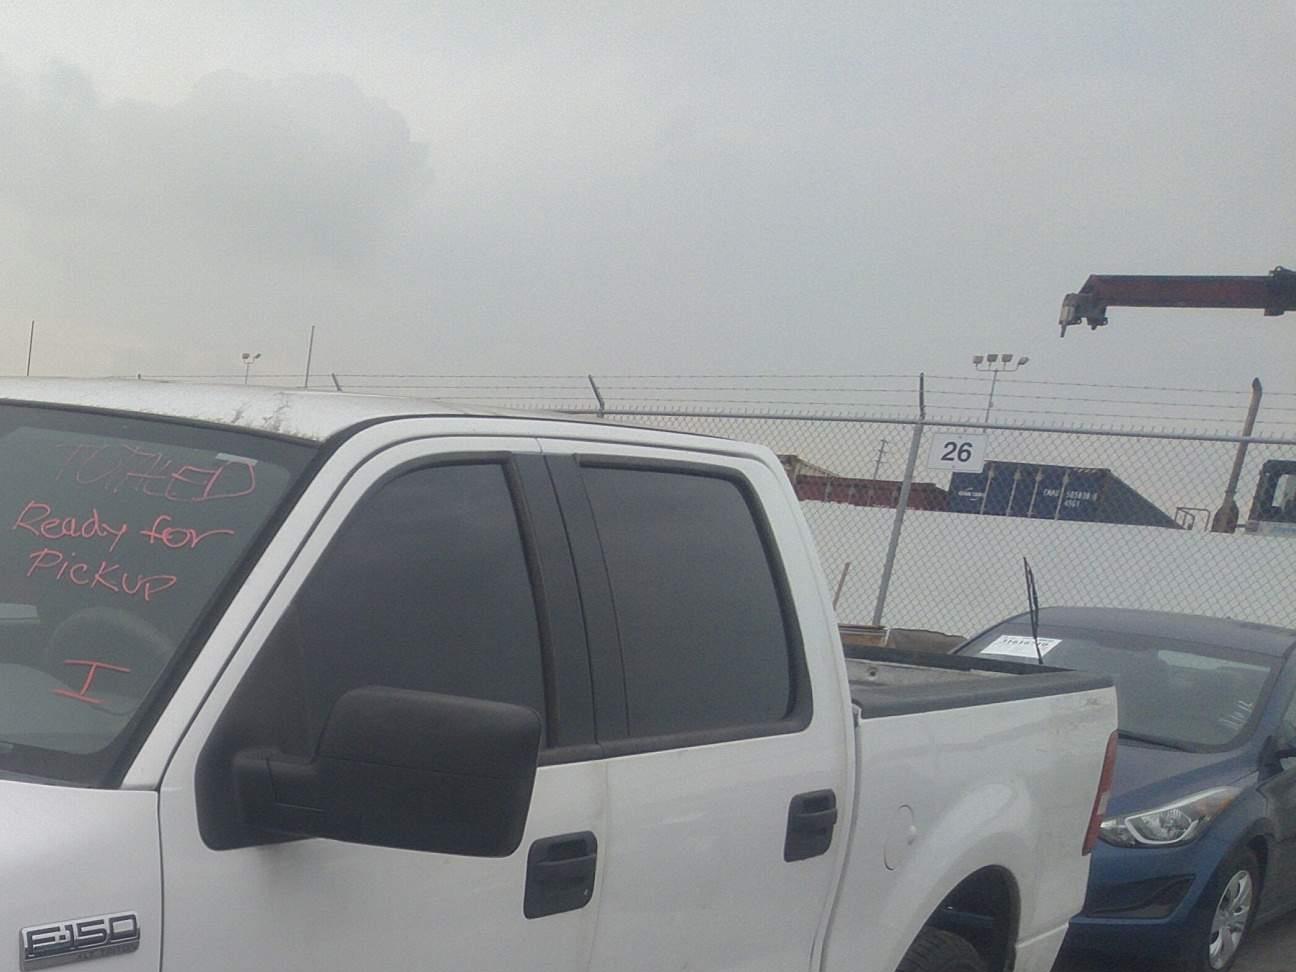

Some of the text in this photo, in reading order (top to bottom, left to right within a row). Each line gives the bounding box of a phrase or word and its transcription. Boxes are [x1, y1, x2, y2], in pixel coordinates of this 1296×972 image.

[942, 441, 973, 462] 26
[13, 500, 235, 552] Ready for
